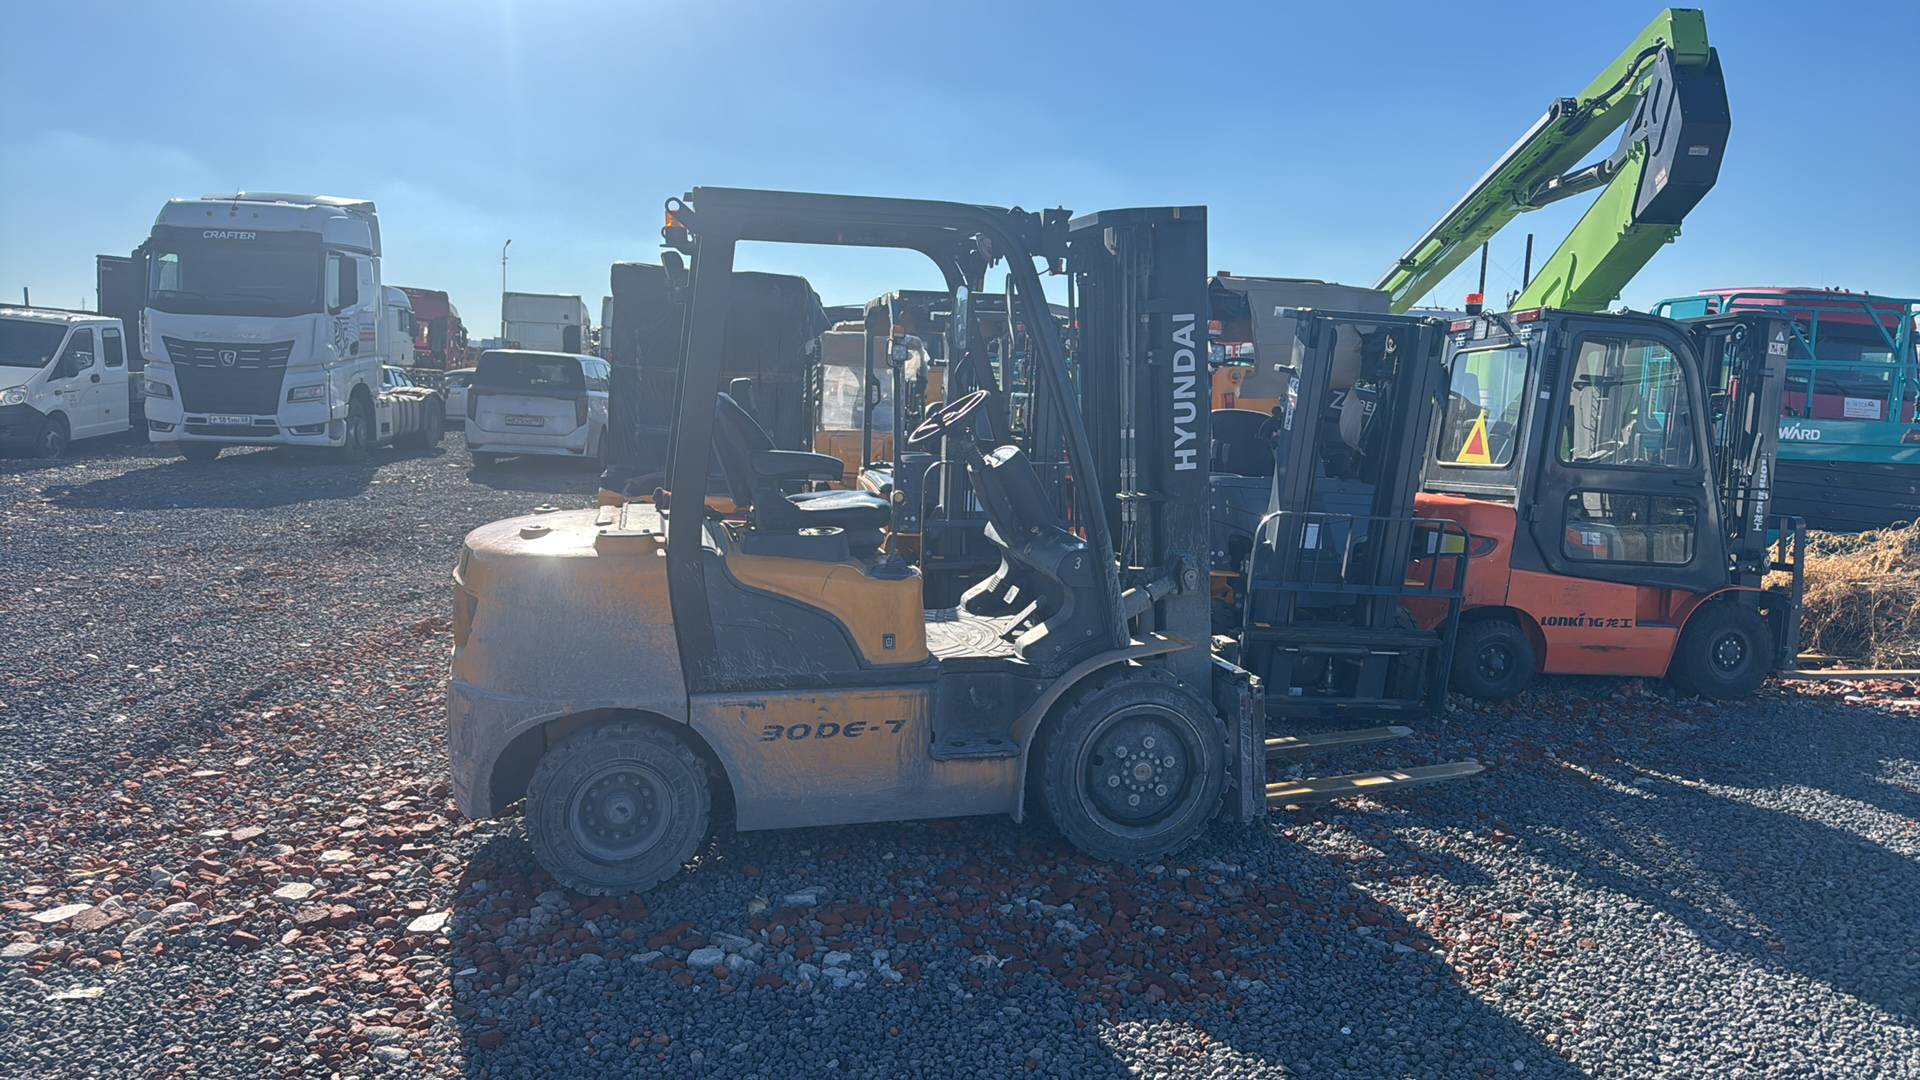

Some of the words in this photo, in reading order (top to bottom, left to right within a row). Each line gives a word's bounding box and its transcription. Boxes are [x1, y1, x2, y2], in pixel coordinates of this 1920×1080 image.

[203, 230, 256, 240] CRAFTER
[1172, 313, 1197, 471] HYUNDAI
[760, 719, 906, 742] 30DE-7
